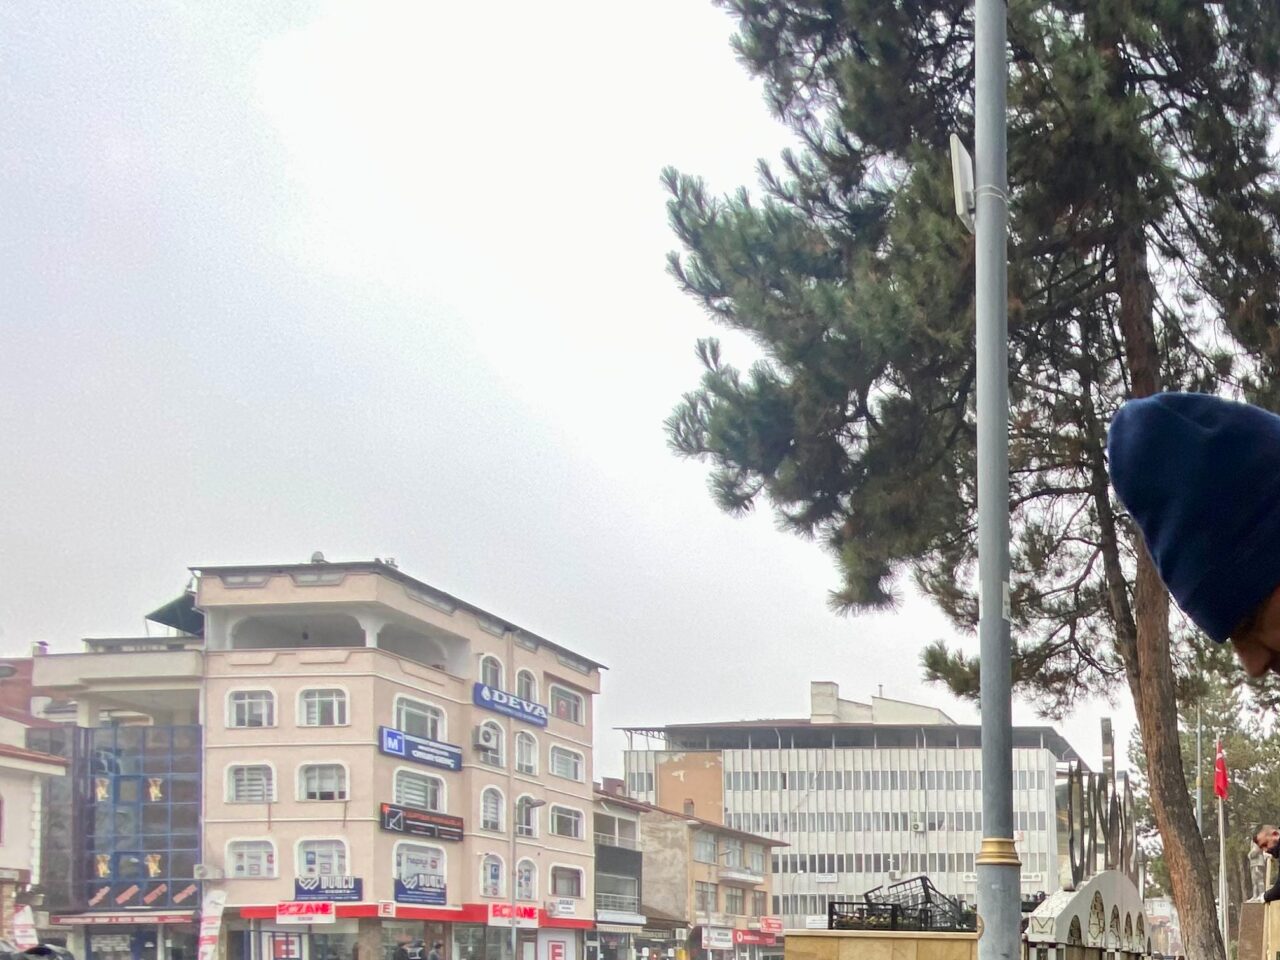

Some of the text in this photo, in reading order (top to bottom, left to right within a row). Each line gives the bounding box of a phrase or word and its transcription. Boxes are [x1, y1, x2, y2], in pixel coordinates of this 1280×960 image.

[493, 689, 547, 718] DEVA
[277, 903, 332, 915] ECZANE
[382, 904, 391, 914] E
